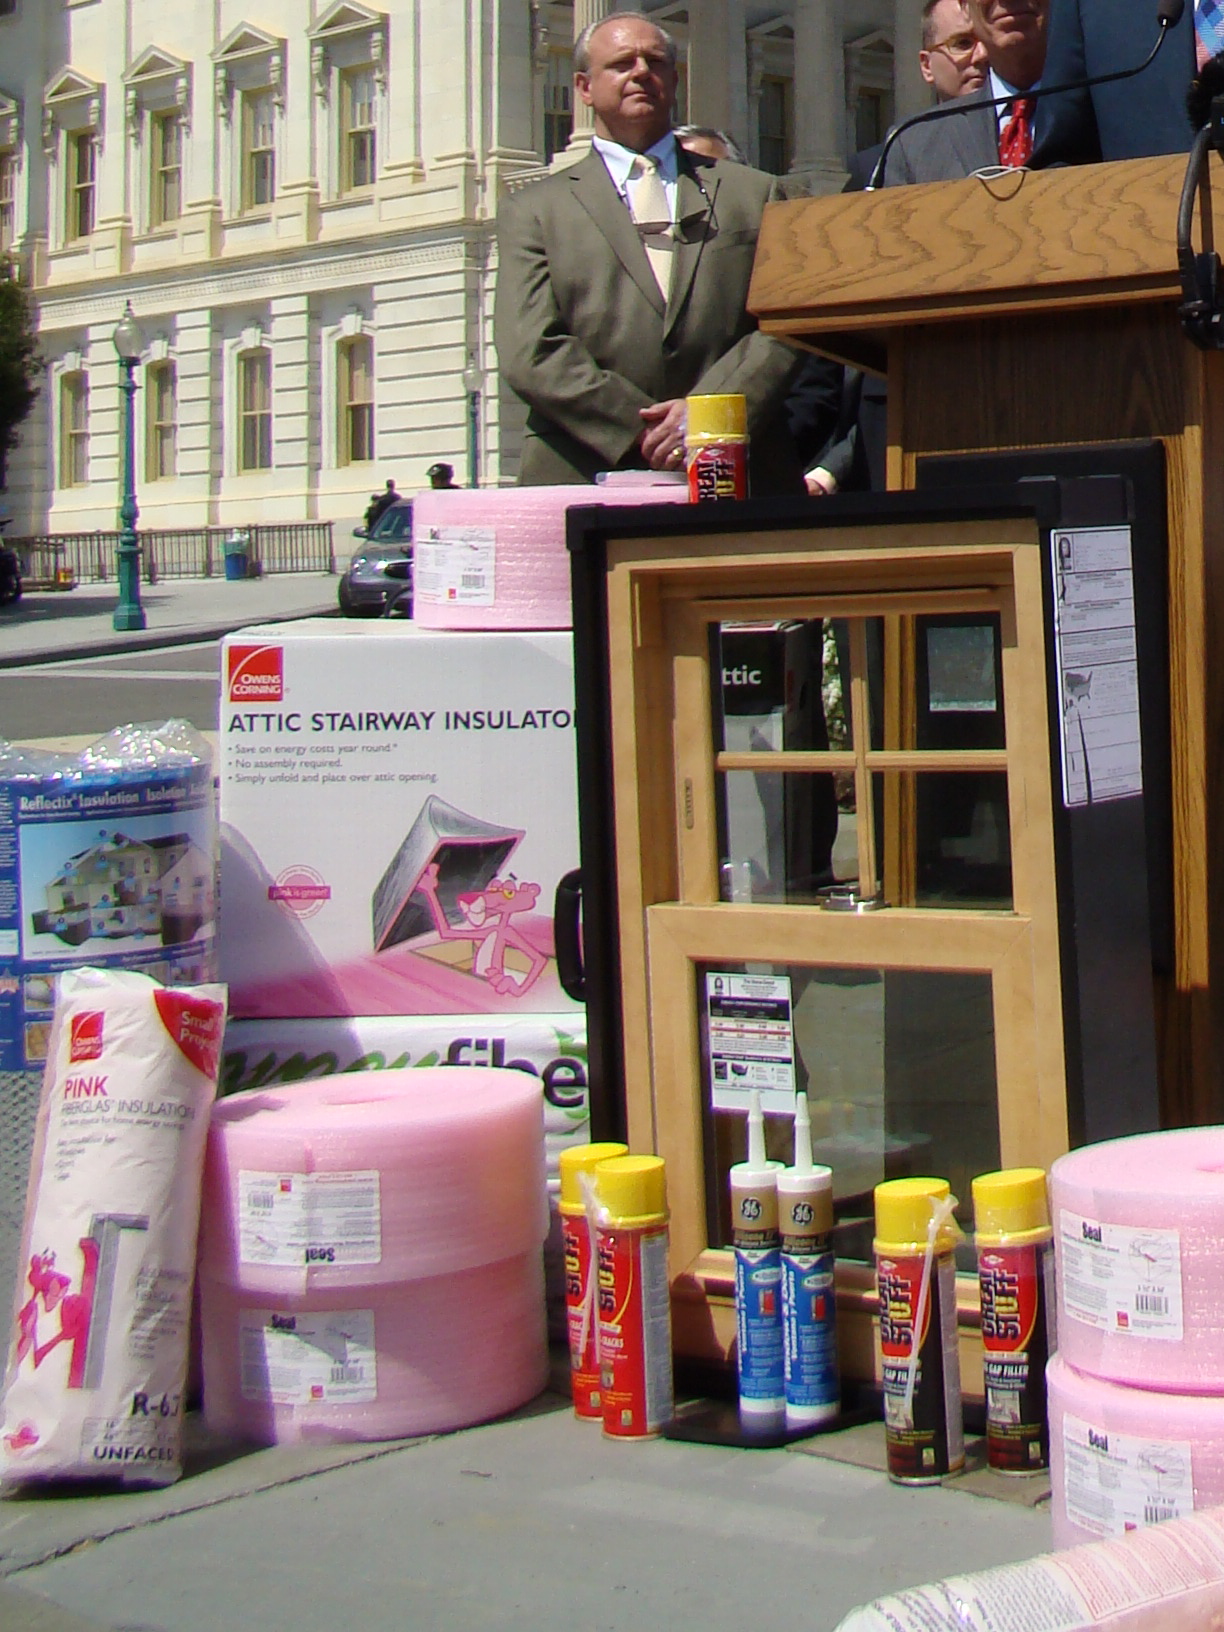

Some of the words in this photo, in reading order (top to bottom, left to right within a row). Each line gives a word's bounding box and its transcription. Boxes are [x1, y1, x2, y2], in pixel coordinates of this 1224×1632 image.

[697, 459, 717, 500] REAT
[716, 458, 736, 500] TUFF
[241, 673, 281, 685] OWENS
[721, 665, 762, 685] ttic
[233, 684, 281, 695] CORNING
[228, 713, 300, 732] ATTIC
[312, 711, 435, 731] STAIRWAY
[445, 709, 577, 729] INSULATO
[235, 744, 256, 753] Save
[275, 745, 306, 755] energy
[310, 745, 334, 753] costs
[338, 745, 358, 755] year
[235, 759, 250, 768] No
[254, 758, 296, 769] assembly
[300, 758, 343, 769] required.
[235, 773, 266, 784] Simply
[269, 772, 299, 782] unfold
[302, 772, 319, 782] and
[322, 772, 346, 784] place
[350, 774, 371, 782] over
[374, 772, 395, 782] attic
[79, 791, 139, 808] Insulation
[181, 1011, 214, 1032] Small
[64, 1076, 109, 1099] PINK
[305, 1247, 335, 1264] Seal
[994, 1269, 1021, 1340] STUFF
